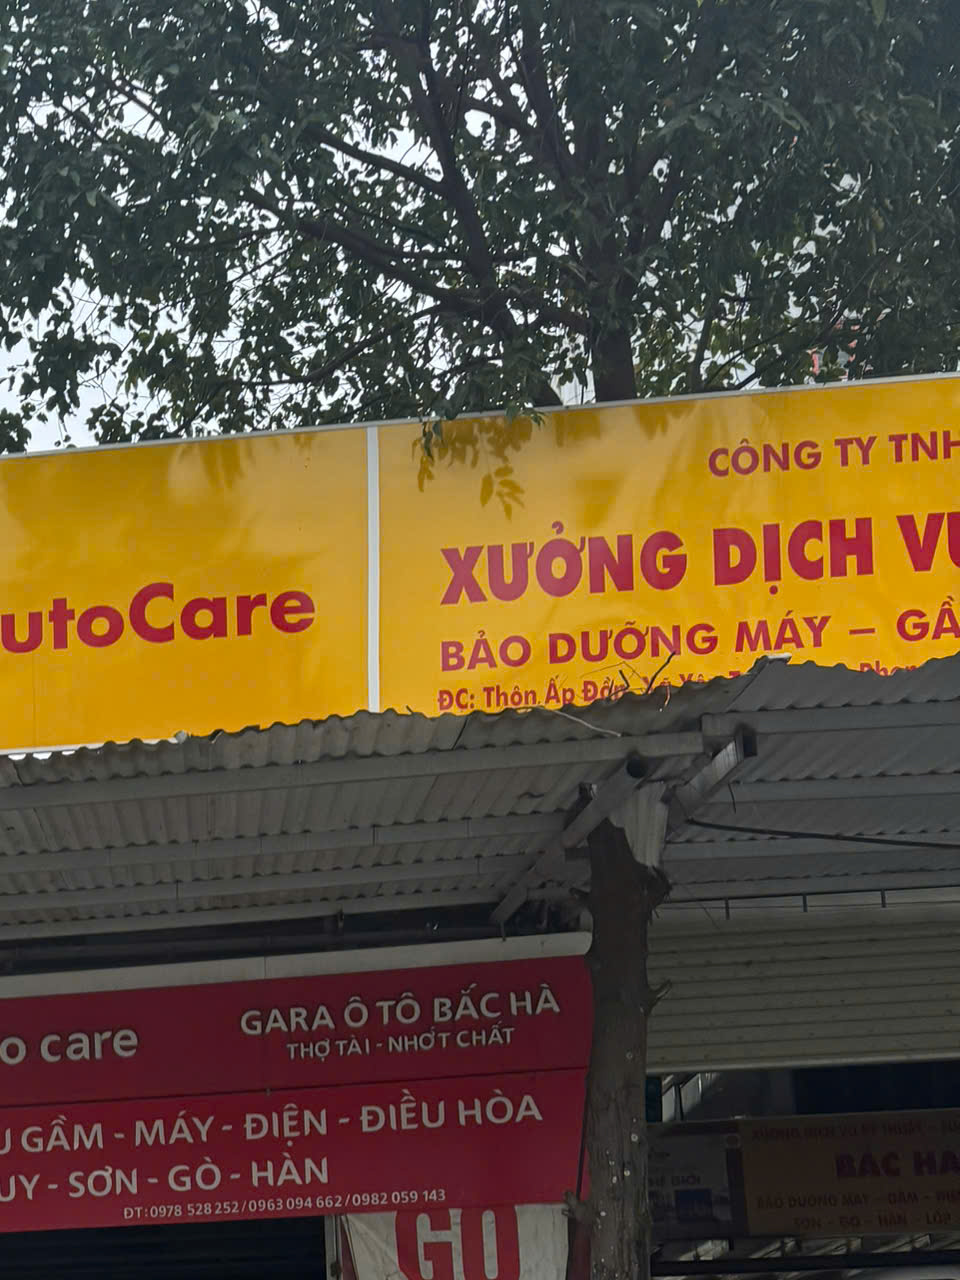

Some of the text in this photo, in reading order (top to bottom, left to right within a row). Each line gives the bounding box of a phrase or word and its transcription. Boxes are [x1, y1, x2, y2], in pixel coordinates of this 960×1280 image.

[708, 438, 822, 478] CÔNG
[834, 435, 877, 468] TY
[440, 520, 688, 606] XƯỞNG
[712, 517, 874, 596] DỊCH
[440, 630, 532, 672] BẢO
[548, 620, 719, 665] DƯỠNG
[735, 610, 831, 653] MÁY
[437, 688, 475, 711] ĐC:
[483, 685, 537, 708] Thôn
[545, 674, 575, 705] Ấp
[239, 982, 561, 1036] GARA Ô TÔ BẮC HÀ
[40, 1028, 139, 1063] care
[286, 1040, 330, 1062] THỢ
[335, 1034, 371, 1057] TÀI
[388, 1025, 451, 1053] NHỚT
[456, 1020, 516, 1048] CHẤT
[20, 1114, 104, 1153] GẦM
[134, 1110, 215, 1148] MÁY
[243, 1102, 328, 1147] ĐIỆN
[359, 1088, 446, 1133] ĐIỀU
[458, 1088, 544, 1127] HÒA
[68, 1165, 139, 1199] SƠN
[167, 1156, 222, 1192] GÒ
[250, 1151, 330, 1188] HÀN
[187, 1202, 212, 1216] 528
[286, 1196, 313, 1210] 094
[391, 1189, 419, 1204] 059
[422, 1188, 446, 1203] 143
